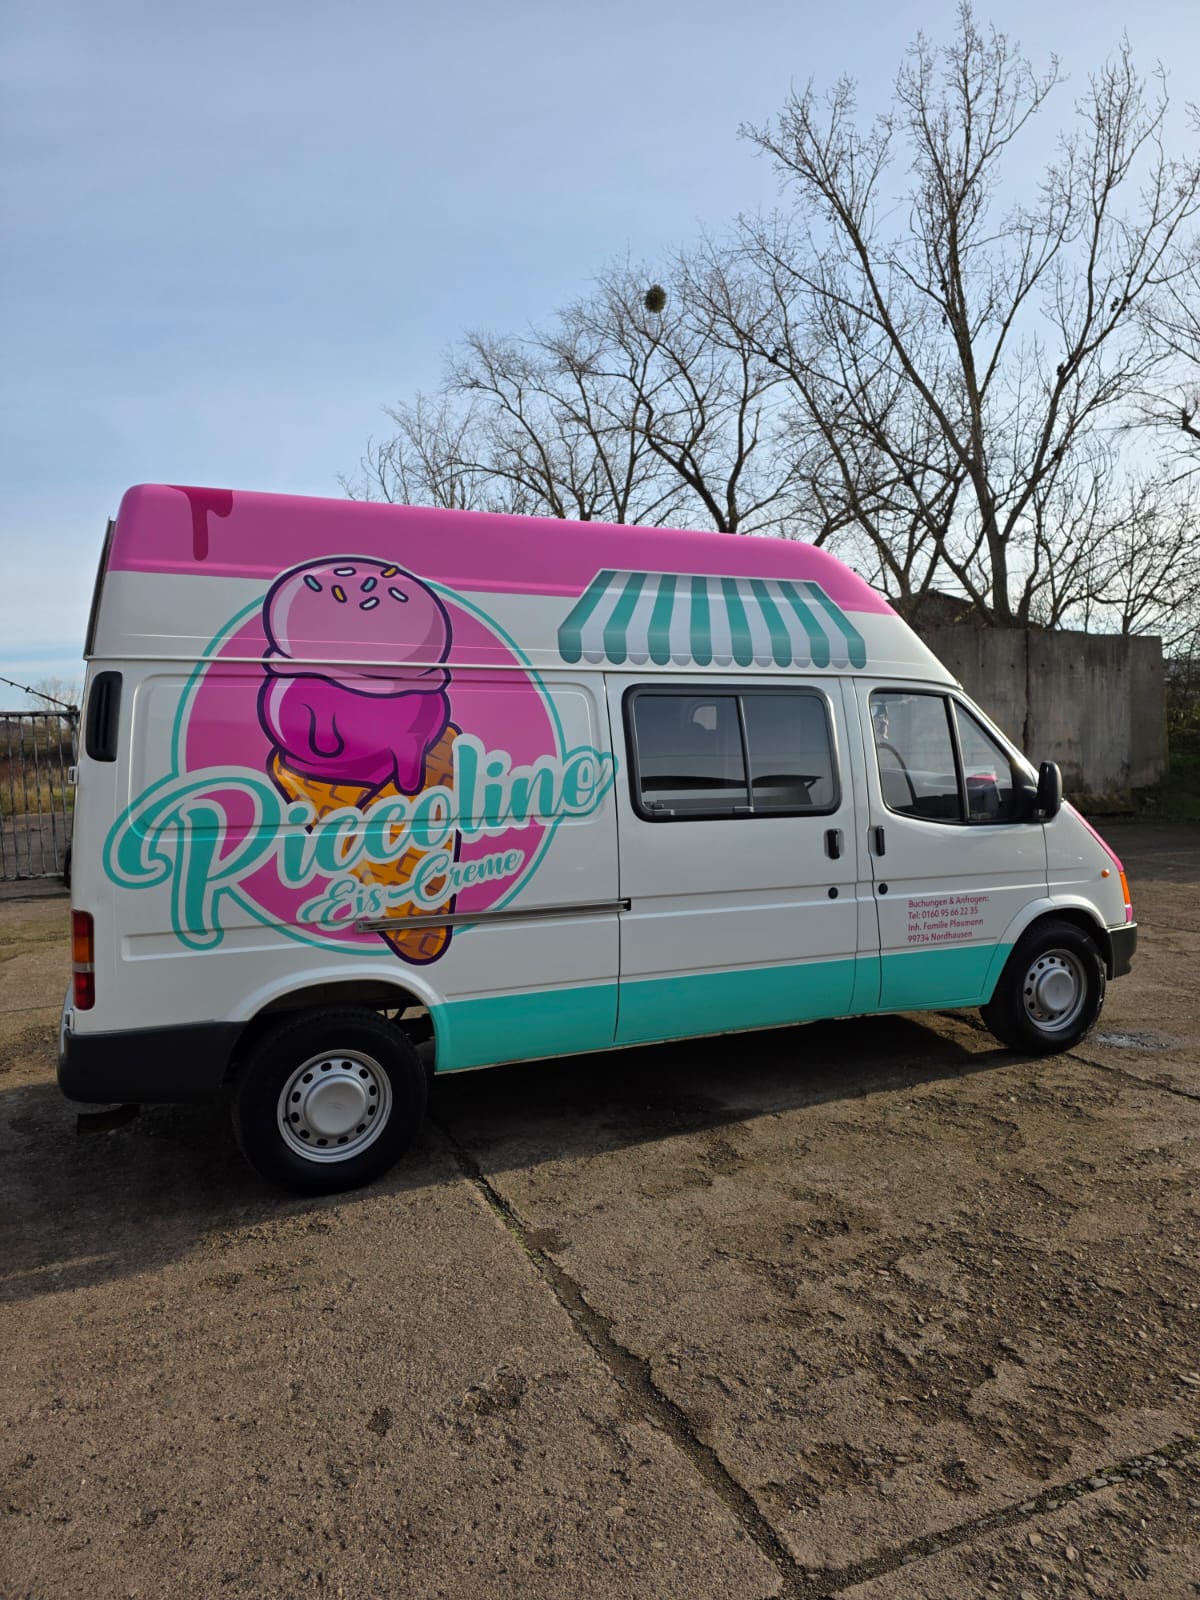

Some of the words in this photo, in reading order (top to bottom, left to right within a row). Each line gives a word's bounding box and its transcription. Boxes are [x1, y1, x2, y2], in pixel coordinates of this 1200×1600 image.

[110, 734, 616, 940] Piccolino
[908, 899, 947, 908] Buchungen
[949, 897, 954, 905] &
[956, 895, 990, 904] Anfragen:
[922, 910, 939, 918] 0160
[941, 909, 949, 917] 95
[950, 908, 959, 916] 66
[960, 907, 968, 915] 22
[970, 906, 978, 914] 35
[908, 923, 921, 931] Inh.
[924, 920, 948, 930] Familie
[908, 934, 929, 942] 99734
[931, 931, 973, 941] Nordhausen
